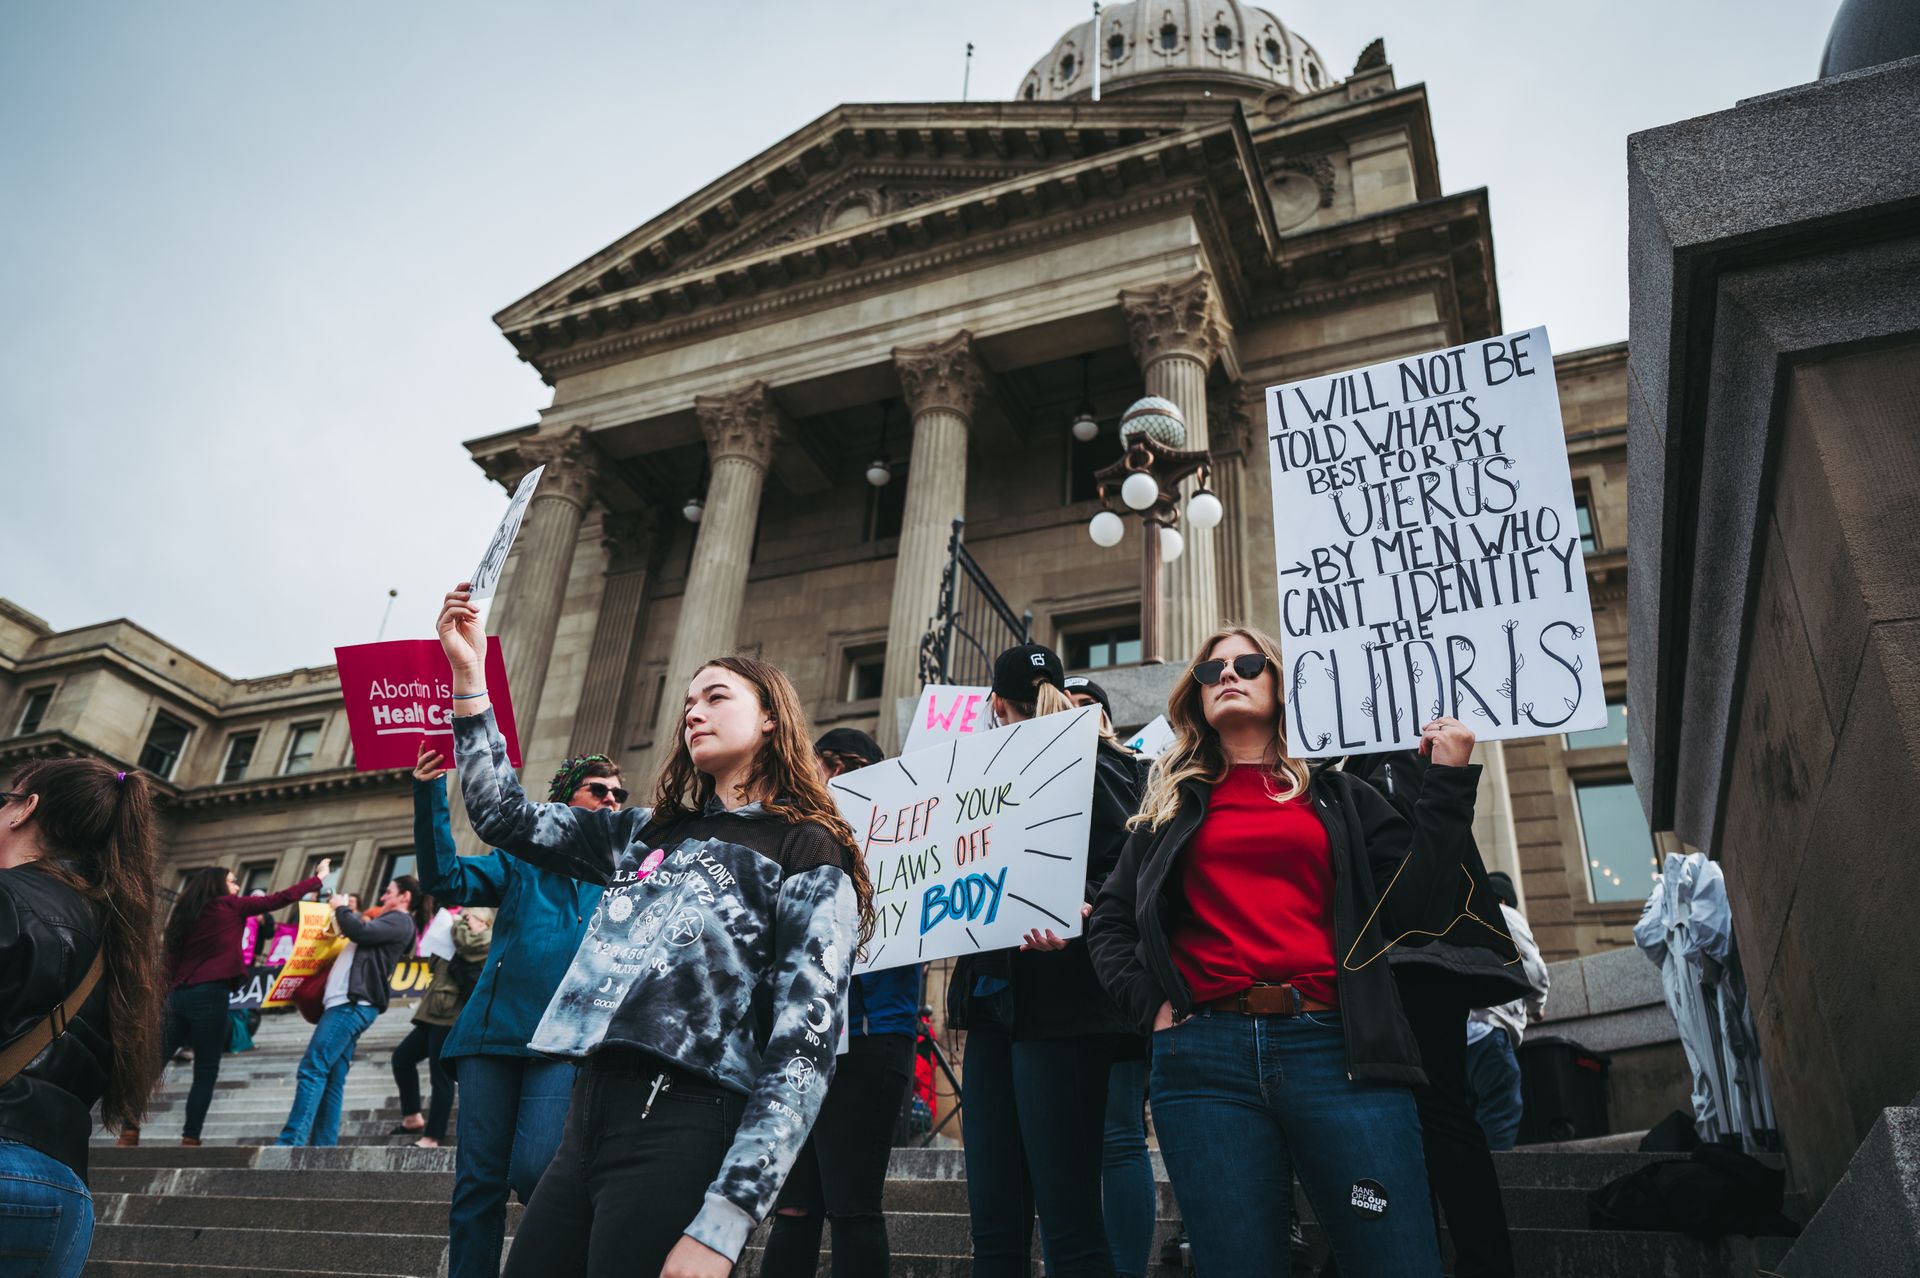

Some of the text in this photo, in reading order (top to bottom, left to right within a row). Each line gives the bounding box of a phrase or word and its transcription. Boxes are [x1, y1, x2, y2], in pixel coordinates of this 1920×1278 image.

[1275, 333, 1536, 430] I WILL NOT BE
[1269, 424, 1346, 473] TOLD
[1306, 425, 1506, 495] BEST FOR MY
[1330, 457, 1519, 537] UTERUS
[1312, 506, 1560, 584] BY MEN WHO
[1283, 537, 1578, 637] CAN'T IDENTIFY
[1369, 615, 1434, 646] THE
[926, 694, 983, 733] WE
[864, 782, 1020, 858] KEEP YOUR
[876, 826, 993, 895] LAWS OFF
[920, 866, 1009, 936] BODY
[805, 1029, 821, 1047] NO
[1351, 1198, 1384, 1213] BODIES
[1352, 1184, 1375, 1197] BANS
[1352, 1191, 1387, 1207] OFF OUR
